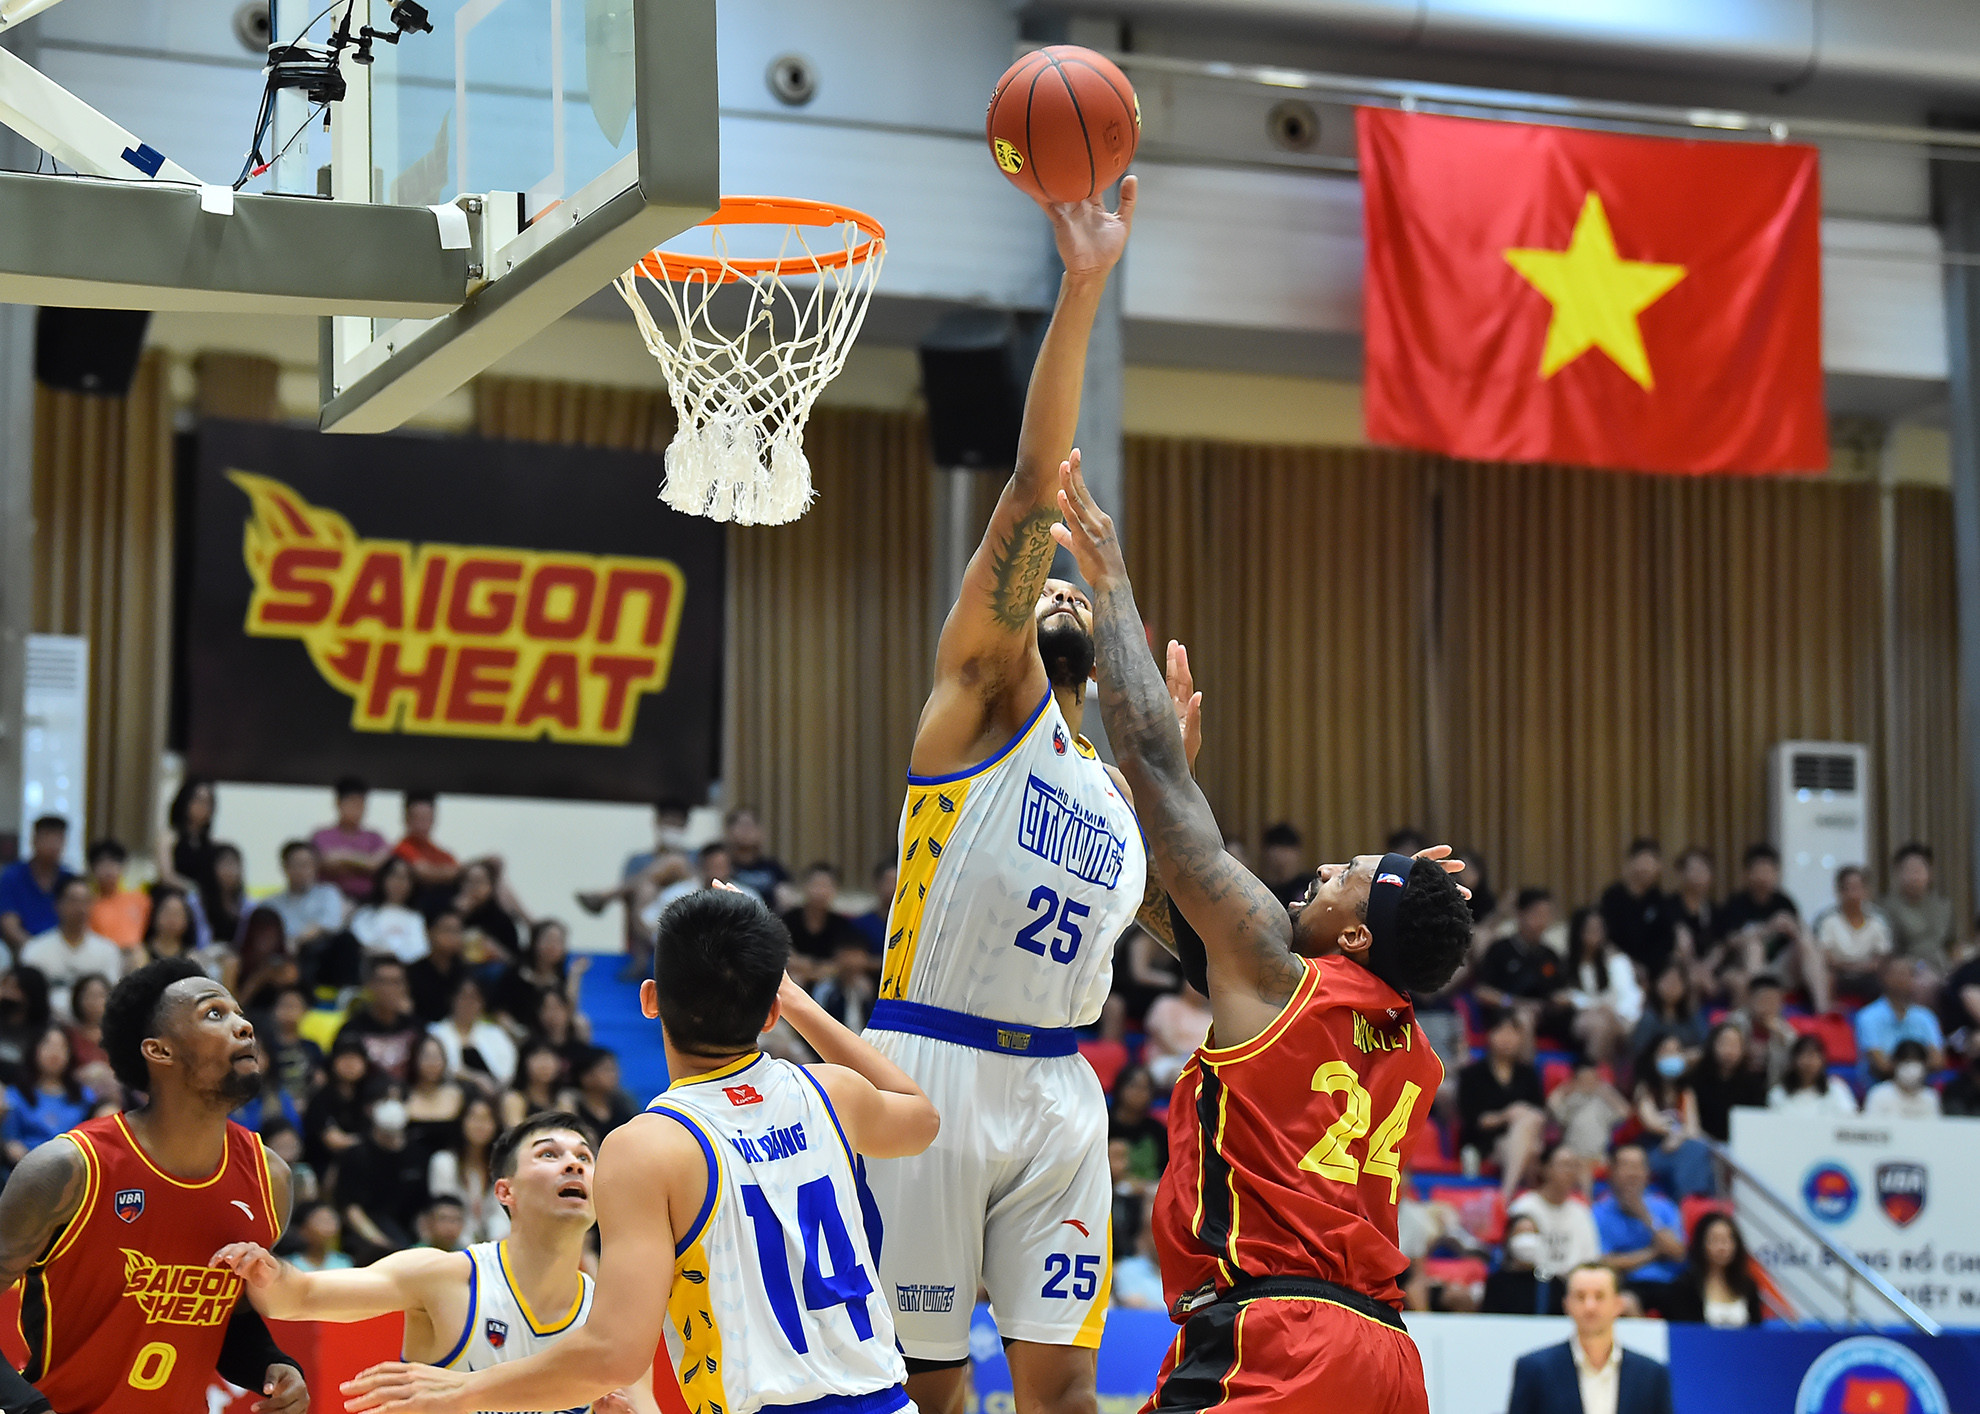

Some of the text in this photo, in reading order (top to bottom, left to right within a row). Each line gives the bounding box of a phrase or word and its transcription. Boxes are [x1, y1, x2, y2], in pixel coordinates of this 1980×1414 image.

[258, 546, 674, 648] SAIGON
[327, 638, 657, 732] HEAT
[1018, 783, 1074, 866] CITY
[1085, 808, 1108, 829] MIN
[1014, 885, 1091, 965] 25
[1298, 1060, 1422, 1205] 24
[119, 1192, 141, 1205] VBA
[123, 1265, 243, 1299] SAIGON
[740, 1175, 874, 1355] 14
[1041, 1253, 1101, 1301] 25
[146, 1294, 236, 1326] HEAT
[897, 1289, 955, 1312] CITY WINGS
[127, 1342, 177, 1390] 0
